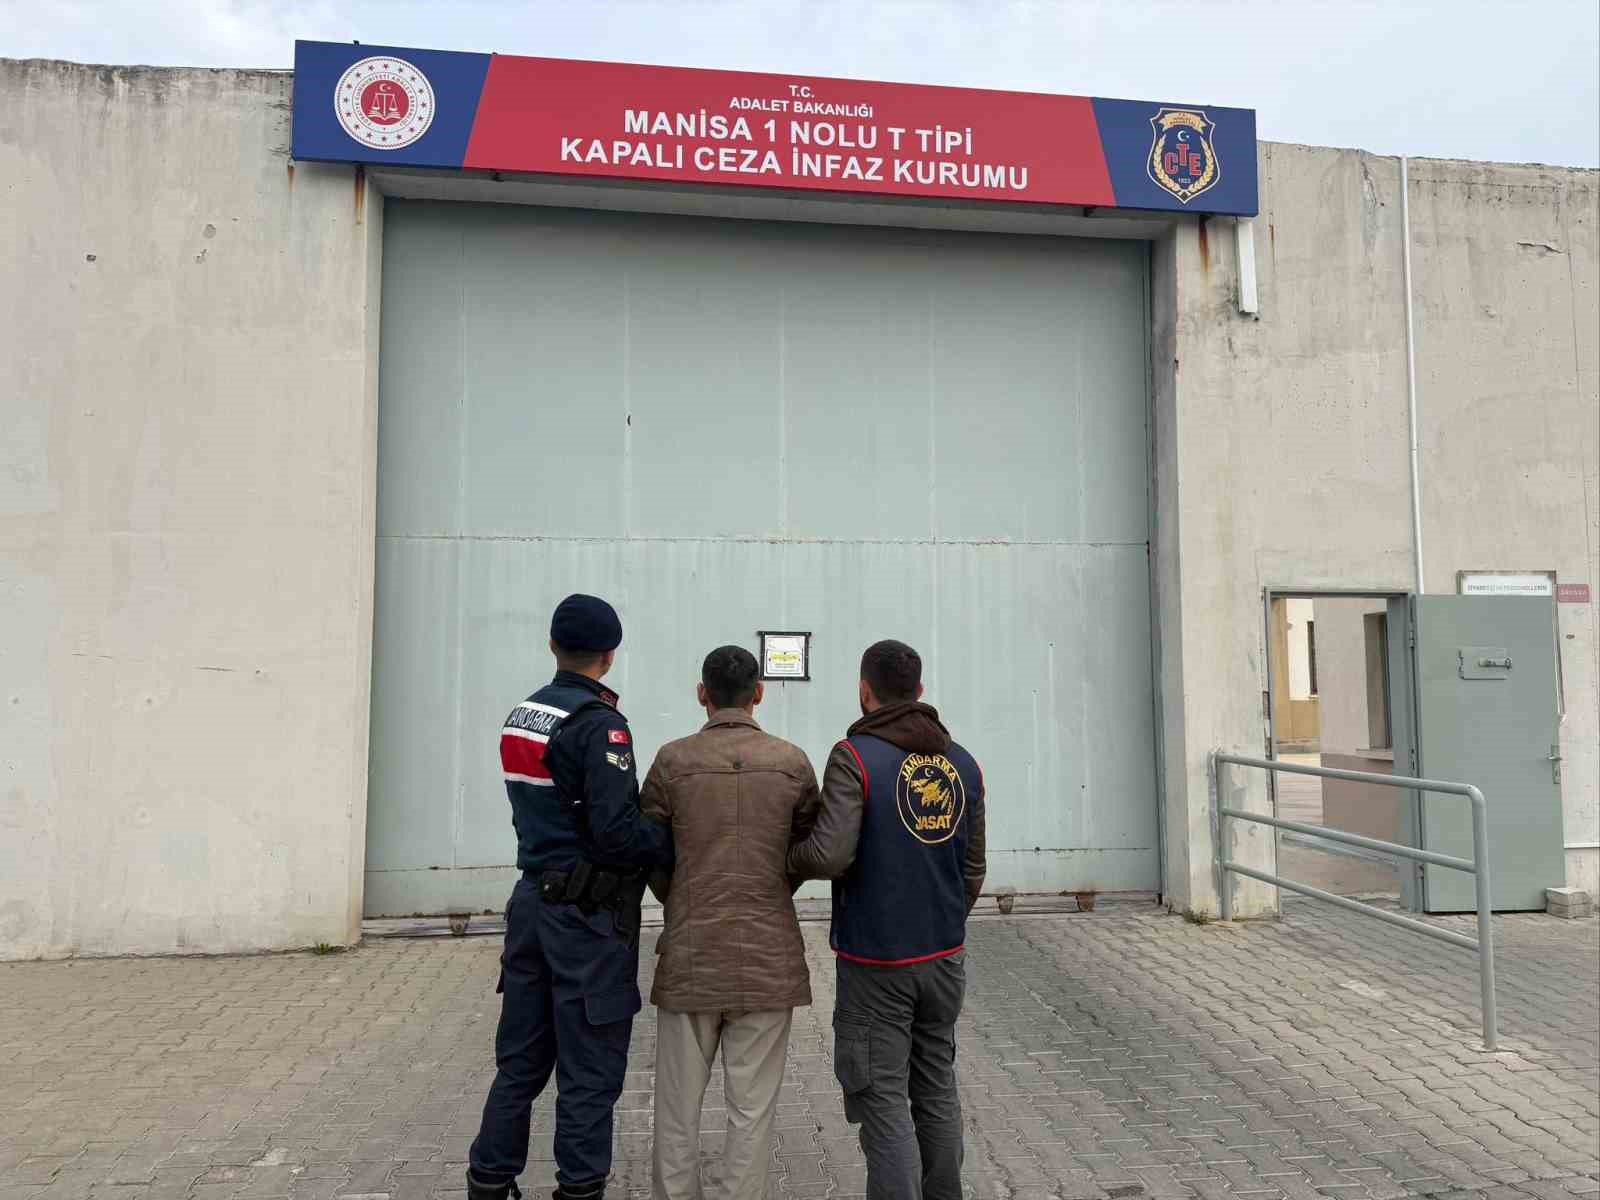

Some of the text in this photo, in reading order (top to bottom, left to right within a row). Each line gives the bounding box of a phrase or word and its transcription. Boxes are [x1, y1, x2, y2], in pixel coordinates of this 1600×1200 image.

[788, 84, 815, 99] T.C.
[729, 96, 873, 118] ADALET BAKANLIĞI
[624, 108, 972, 155] MANİSA 1 NOLU T TİPİ
[561, 137, 1028, 190] KAPALI CEZA İNFAZ KURUMU
[1164, 143, 1202, 176] CTE
[901, 753, 956, 782] JANDARMA
[915, 814, 951, 831] JASAT
